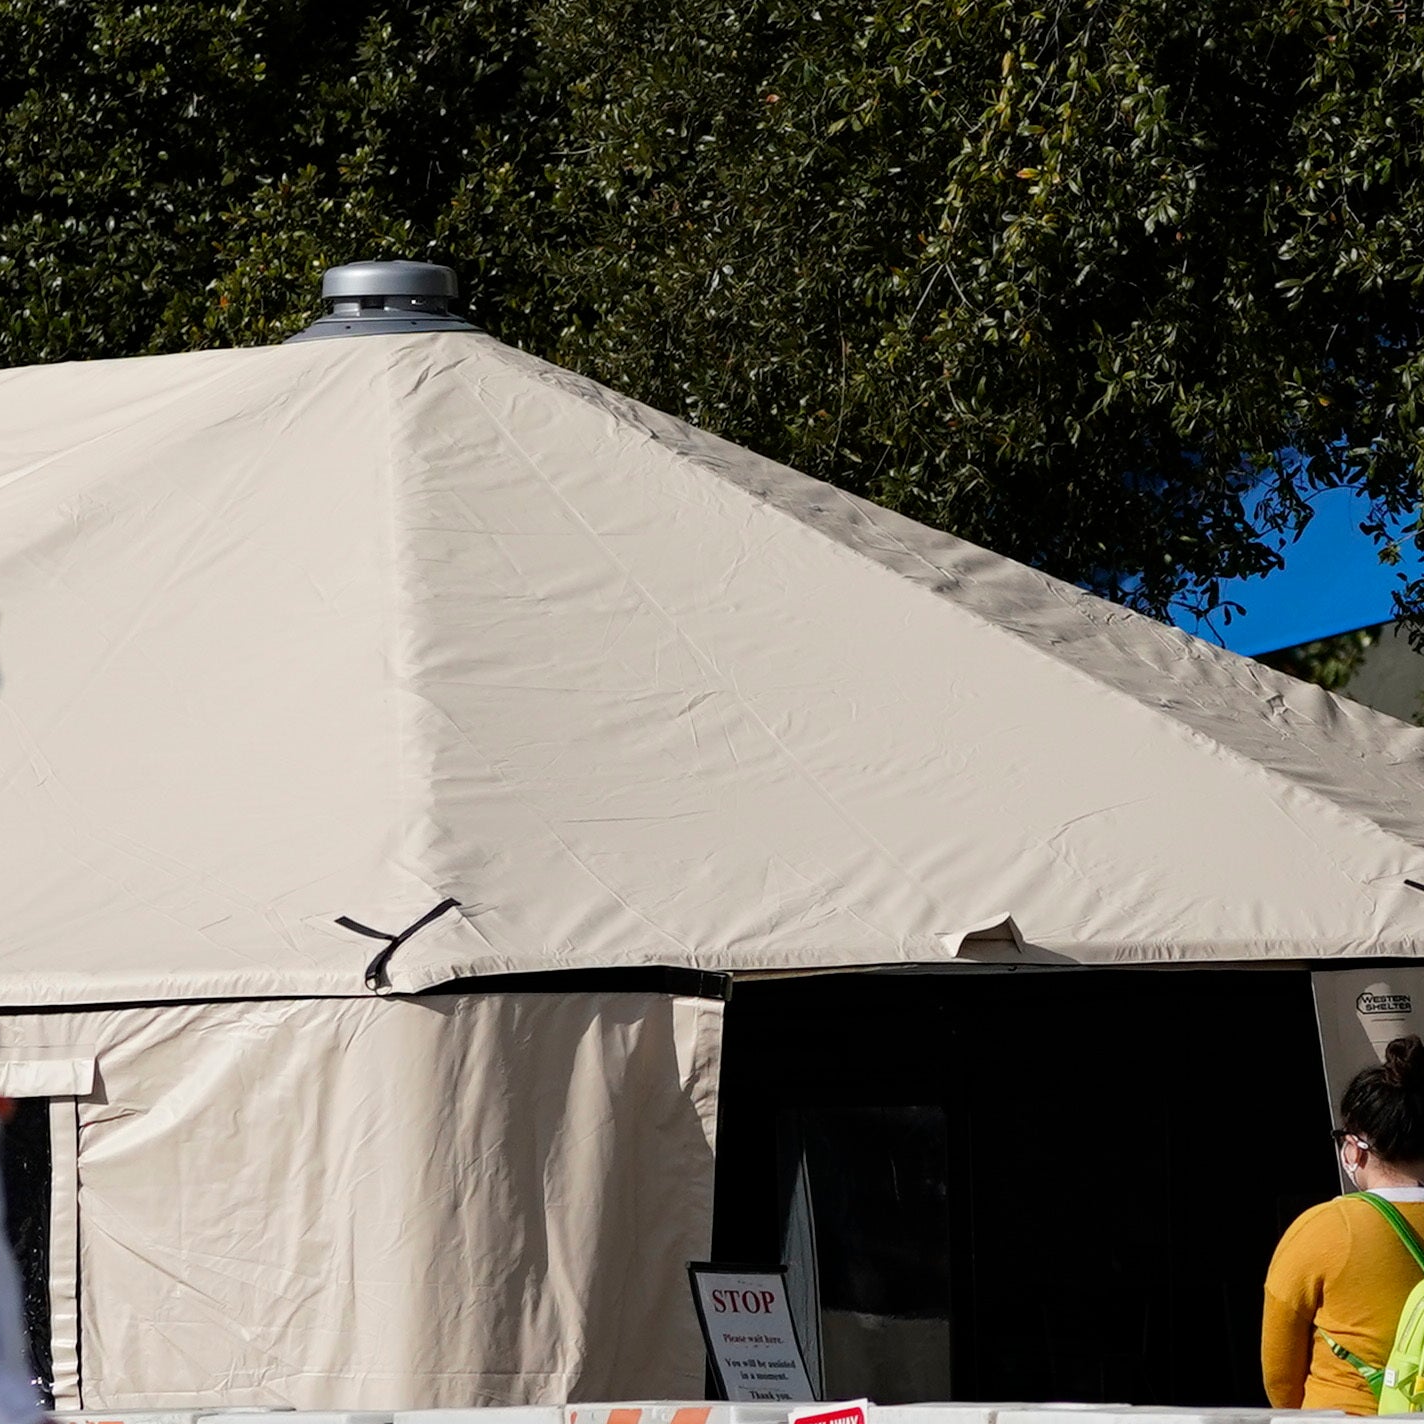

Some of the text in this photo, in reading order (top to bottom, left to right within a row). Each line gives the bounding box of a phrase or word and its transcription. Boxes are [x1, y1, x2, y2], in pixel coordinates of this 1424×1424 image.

[712, 1289, 775, 1314] STOP
[725, 1358, 741, 1368] You
[742, 1359, 756, 1368] will
